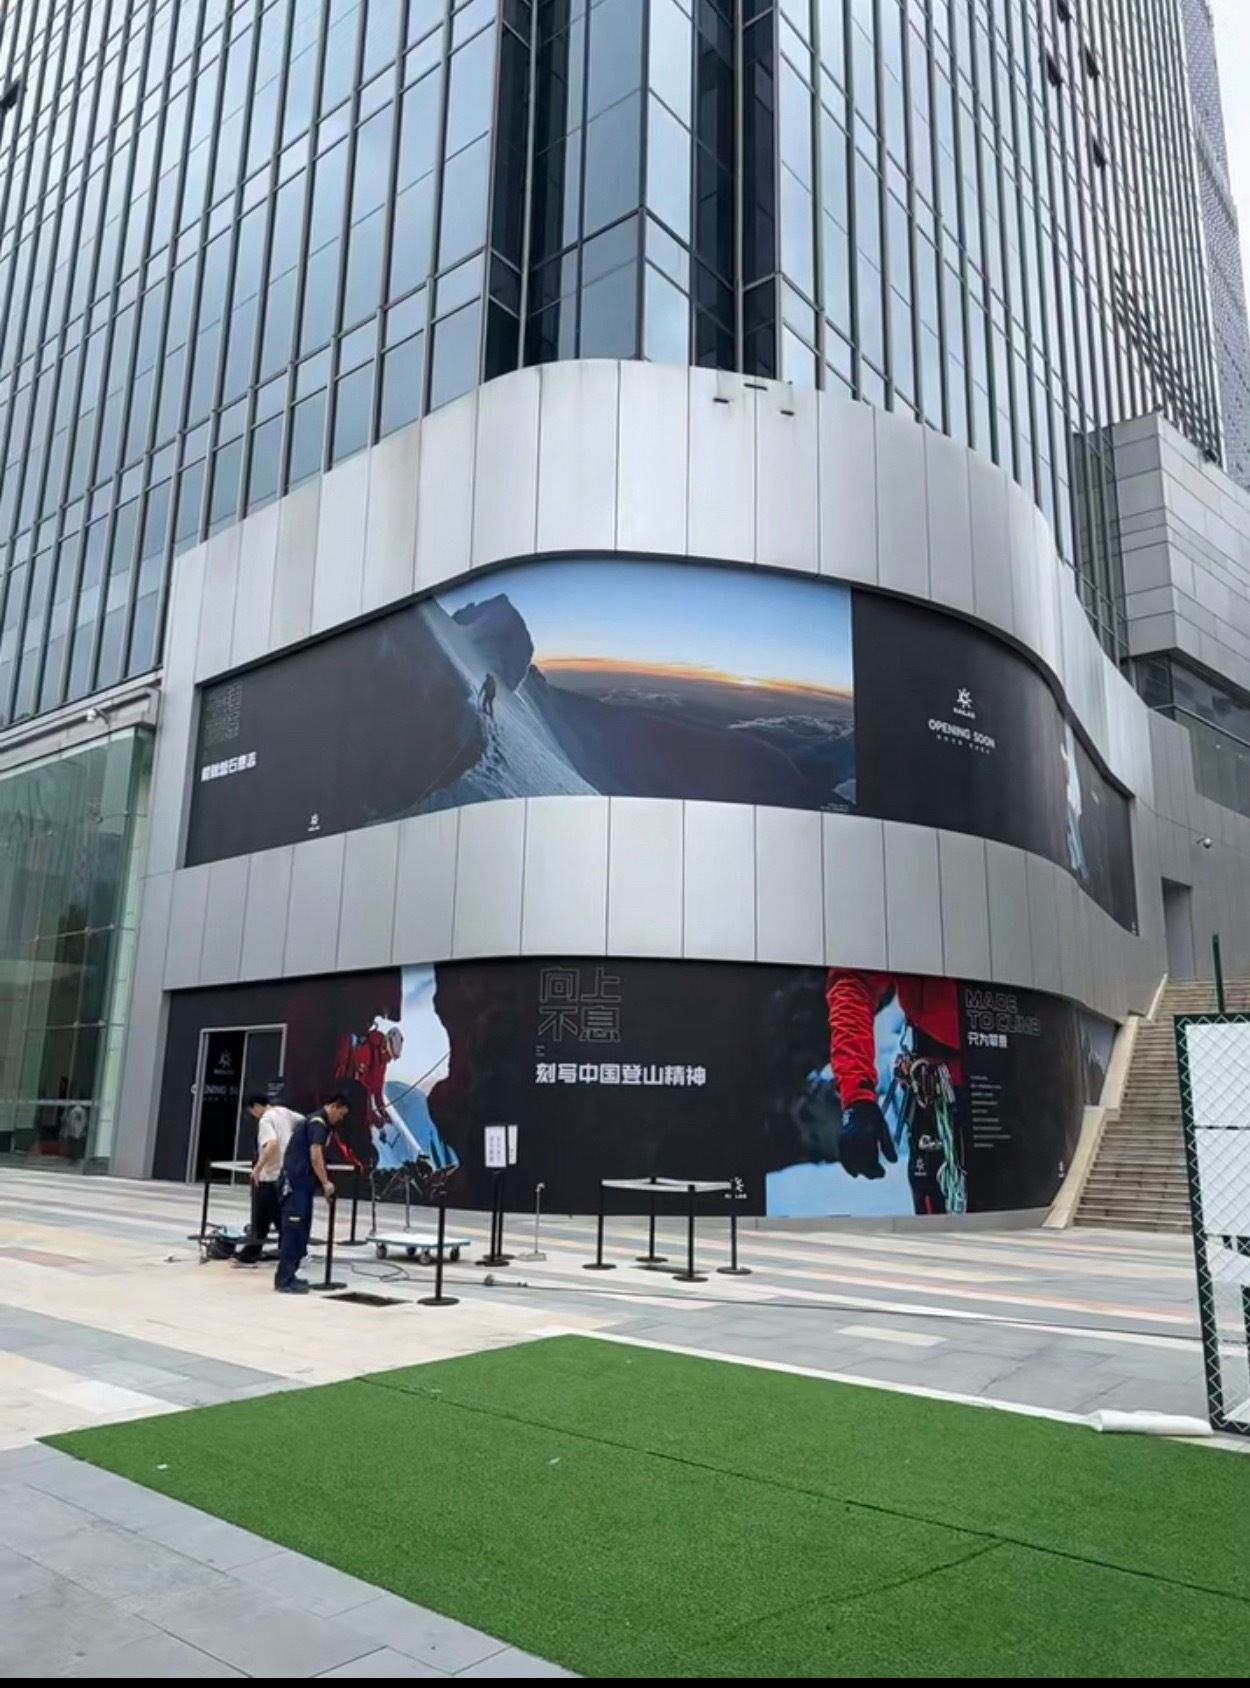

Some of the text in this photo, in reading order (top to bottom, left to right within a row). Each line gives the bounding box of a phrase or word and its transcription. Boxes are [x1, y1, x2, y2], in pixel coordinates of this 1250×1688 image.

[928, 718, 971, 740] OPENING
[973, 730, 996, 749] SOON
[539, 966, 622, 1003] 向上
[965, 988, 1018, 1014] MADE
[538, 1005, 622, 1043] 不息
[966, 1009, 995, 1032] TO
[535, 1062, 707, 1087] 刻写中国登山精神
